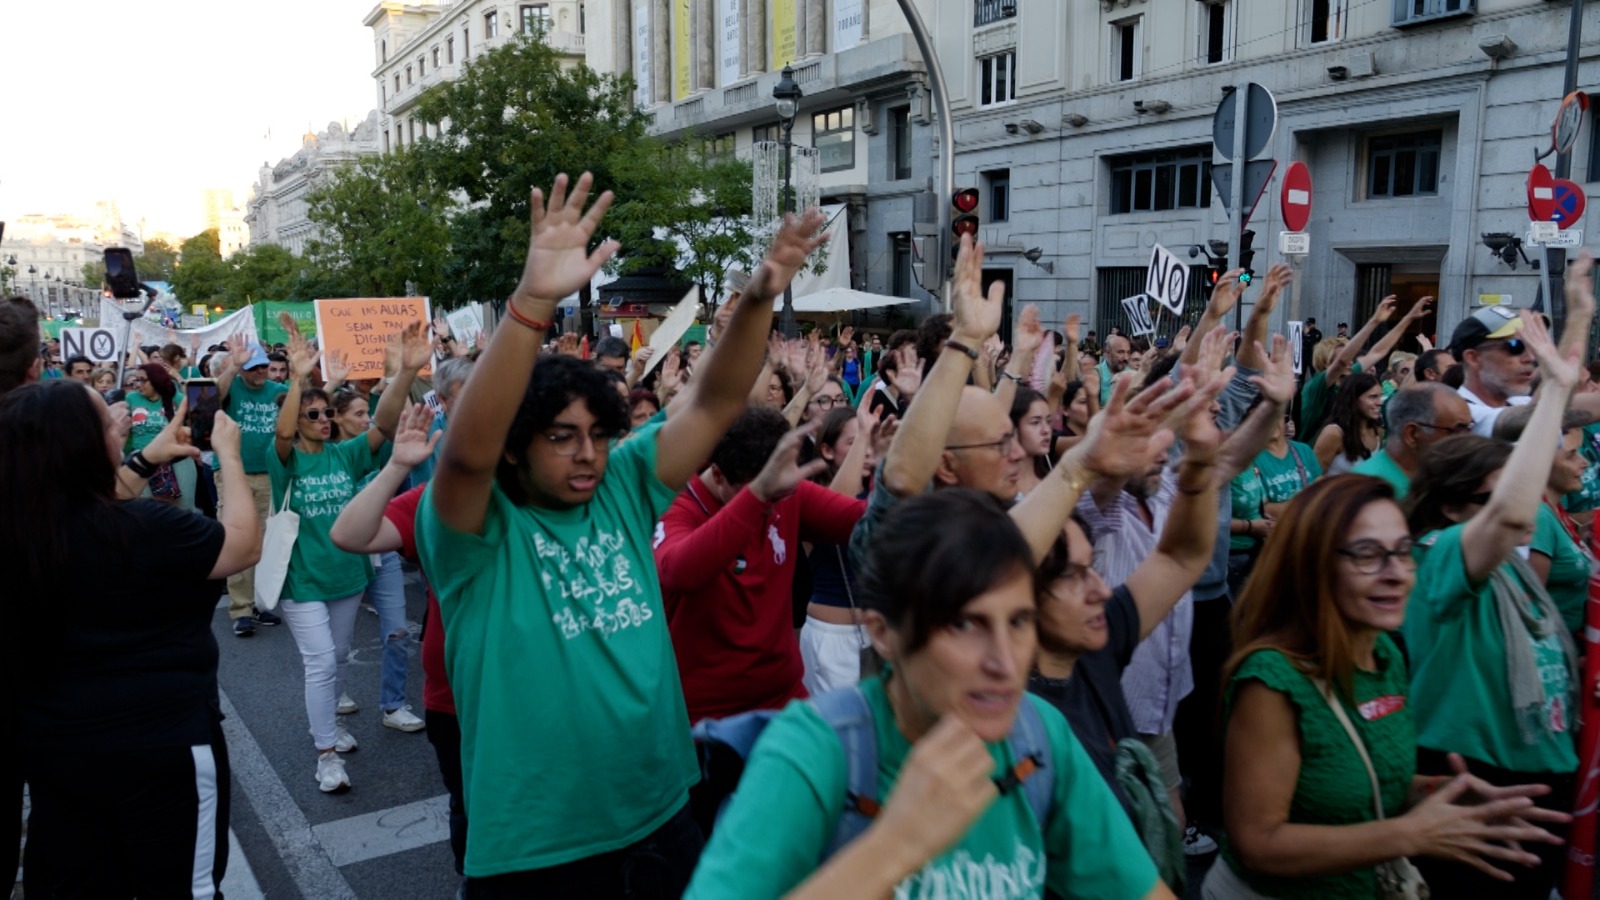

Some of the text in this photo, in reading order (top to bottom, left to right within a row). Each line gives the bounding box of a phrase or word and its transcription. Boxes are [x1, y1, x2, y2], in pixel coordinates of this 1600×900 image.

[1150, 248, 1185, 308] NO
[330, 307, 352, 317] QUE
[380, 304, 418, 317] AULAS
[1125, 296, 1153, 333] NO
[346, 321, 403, 332] SEAN TAN
[63, 330, 115, 361] NO
[361, 347, 387, 355] COM
